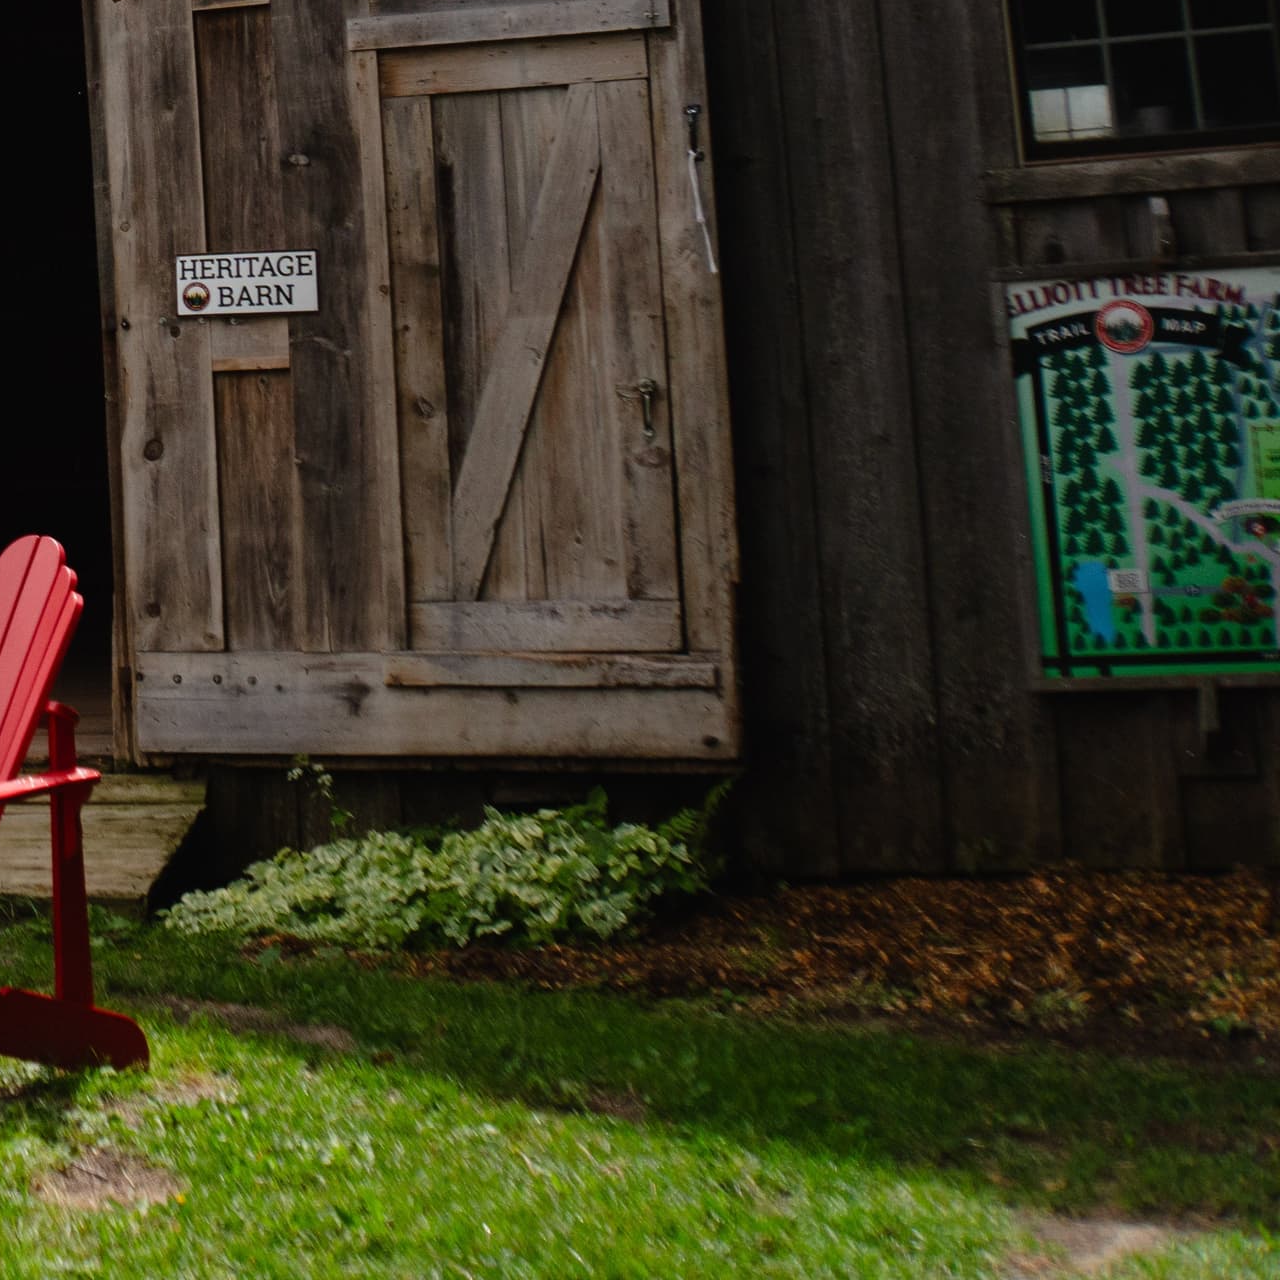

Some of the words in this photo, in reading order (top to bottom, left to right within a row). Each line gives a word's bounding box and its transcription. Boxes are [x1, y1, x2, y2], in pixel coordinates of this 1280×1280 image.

[179, 255, 313, 280] HERITAGE
[217, 284, 295, 307] BARN
[1104, 273, 1169, 297] TREE
[1173, 275, 1247, 305] FARM
[1034, 322, 1091, 345] TRAIL
[1160, 317, 1207, 334] MAP
